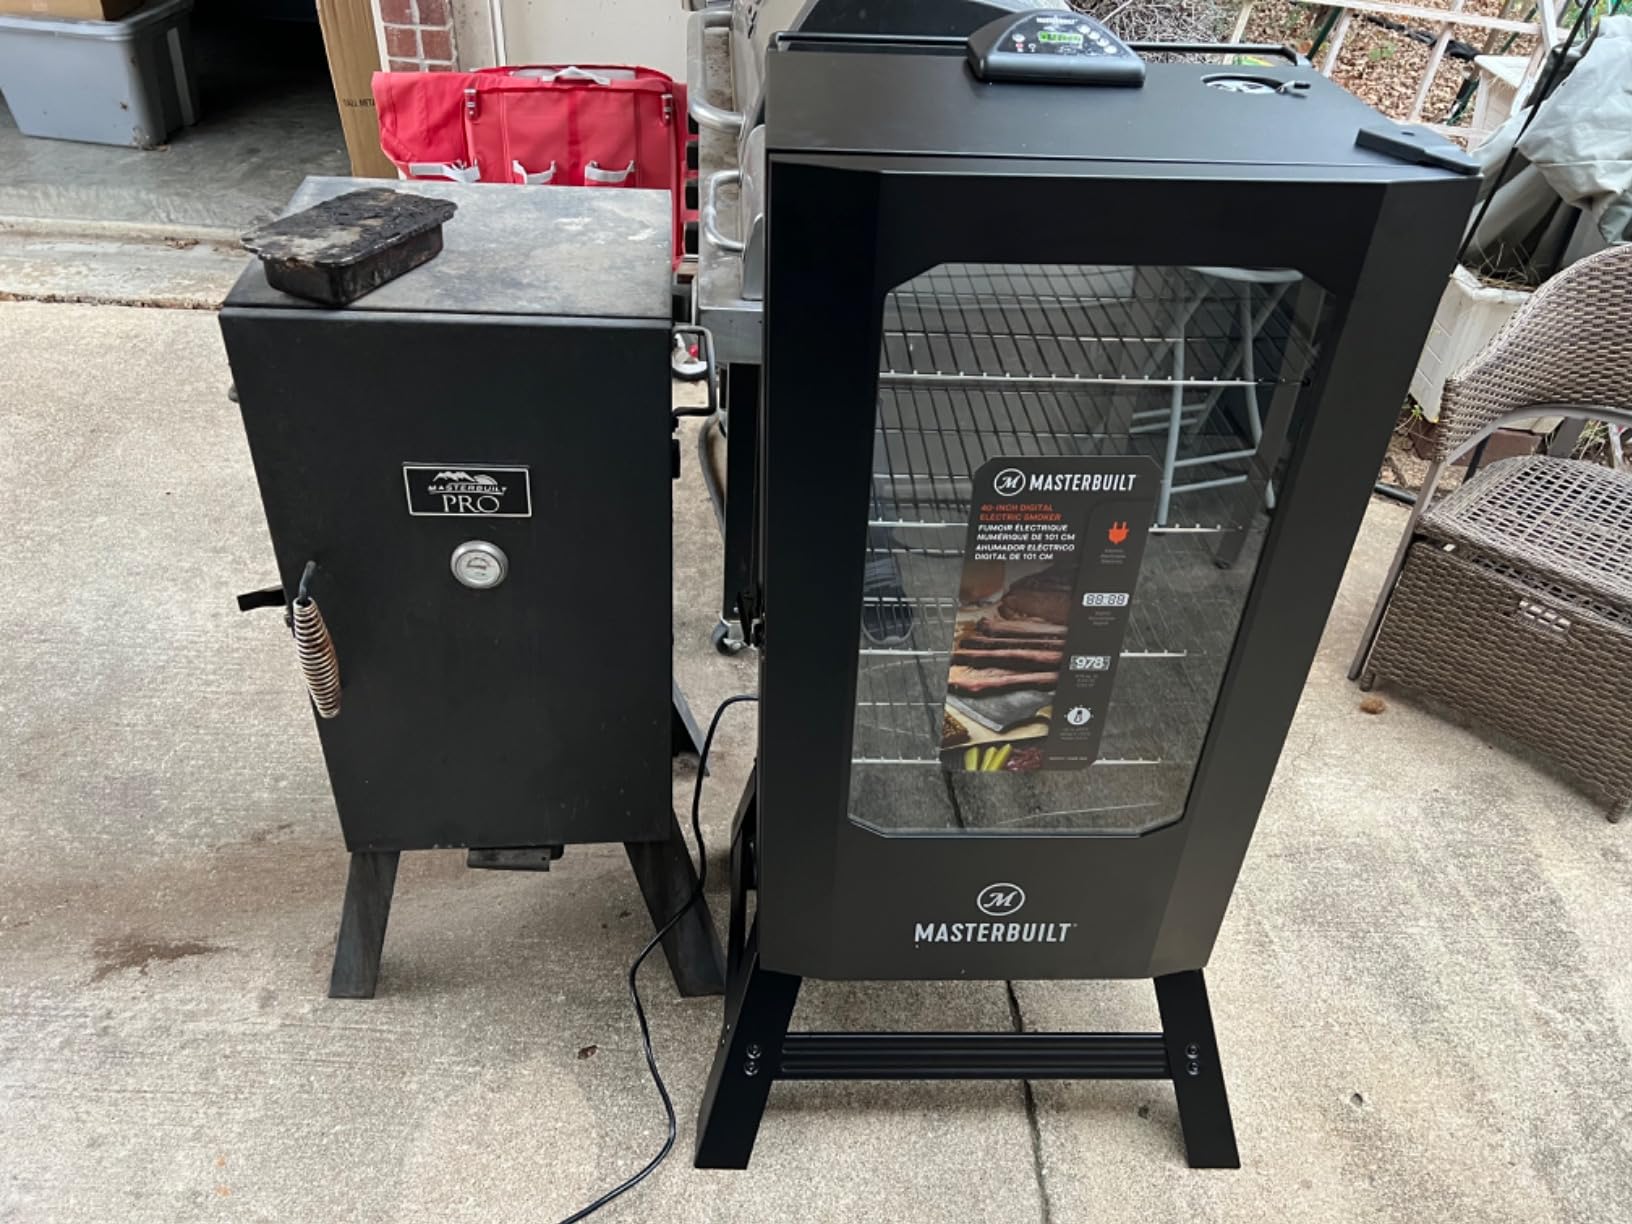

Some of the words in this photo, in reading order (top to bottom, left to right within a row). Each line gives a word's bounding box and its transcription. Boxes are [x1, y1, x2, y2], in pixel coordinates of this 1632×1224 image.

[1029, 474, 1136, 491] MASTERBUILT
[428, 484, 507, 493] MASTERBUILT
[442, 495, 500, 513] PRO
[980, 503, 1018, 512] 40-INCH
[1020, 503, 1053, 512] DIGITAL
[979, 513, 1022, 521] ELECTRIC
[1023, 513, 1062, 521] SMOKER
[978, 524, 1014, 532] FUMOIR
[1014, 522, 1068, 532] ÉLECTRIQUE
[976, 532, 1029, 541] NUMÉRIQUE
[1031, 533, 1042, 541] DE
[1045, 533, 1059, 541] 101
[1060, 533, 1076, 541] CM
[975, 543, 1026, 552] AHUMADOR
[1026, 542, 1075, 552] ELÉCTRICO
[974, 553, 1007, 561] DIGITAL
[1008, 553, 1020, 561] DE
[1023, 553, 1037, 561] 101
[1038, 553, 1054, 561] CM
[1076, 657, 1105, 669] 978
[915, 923, 1071, 942] MASTERBUILT
